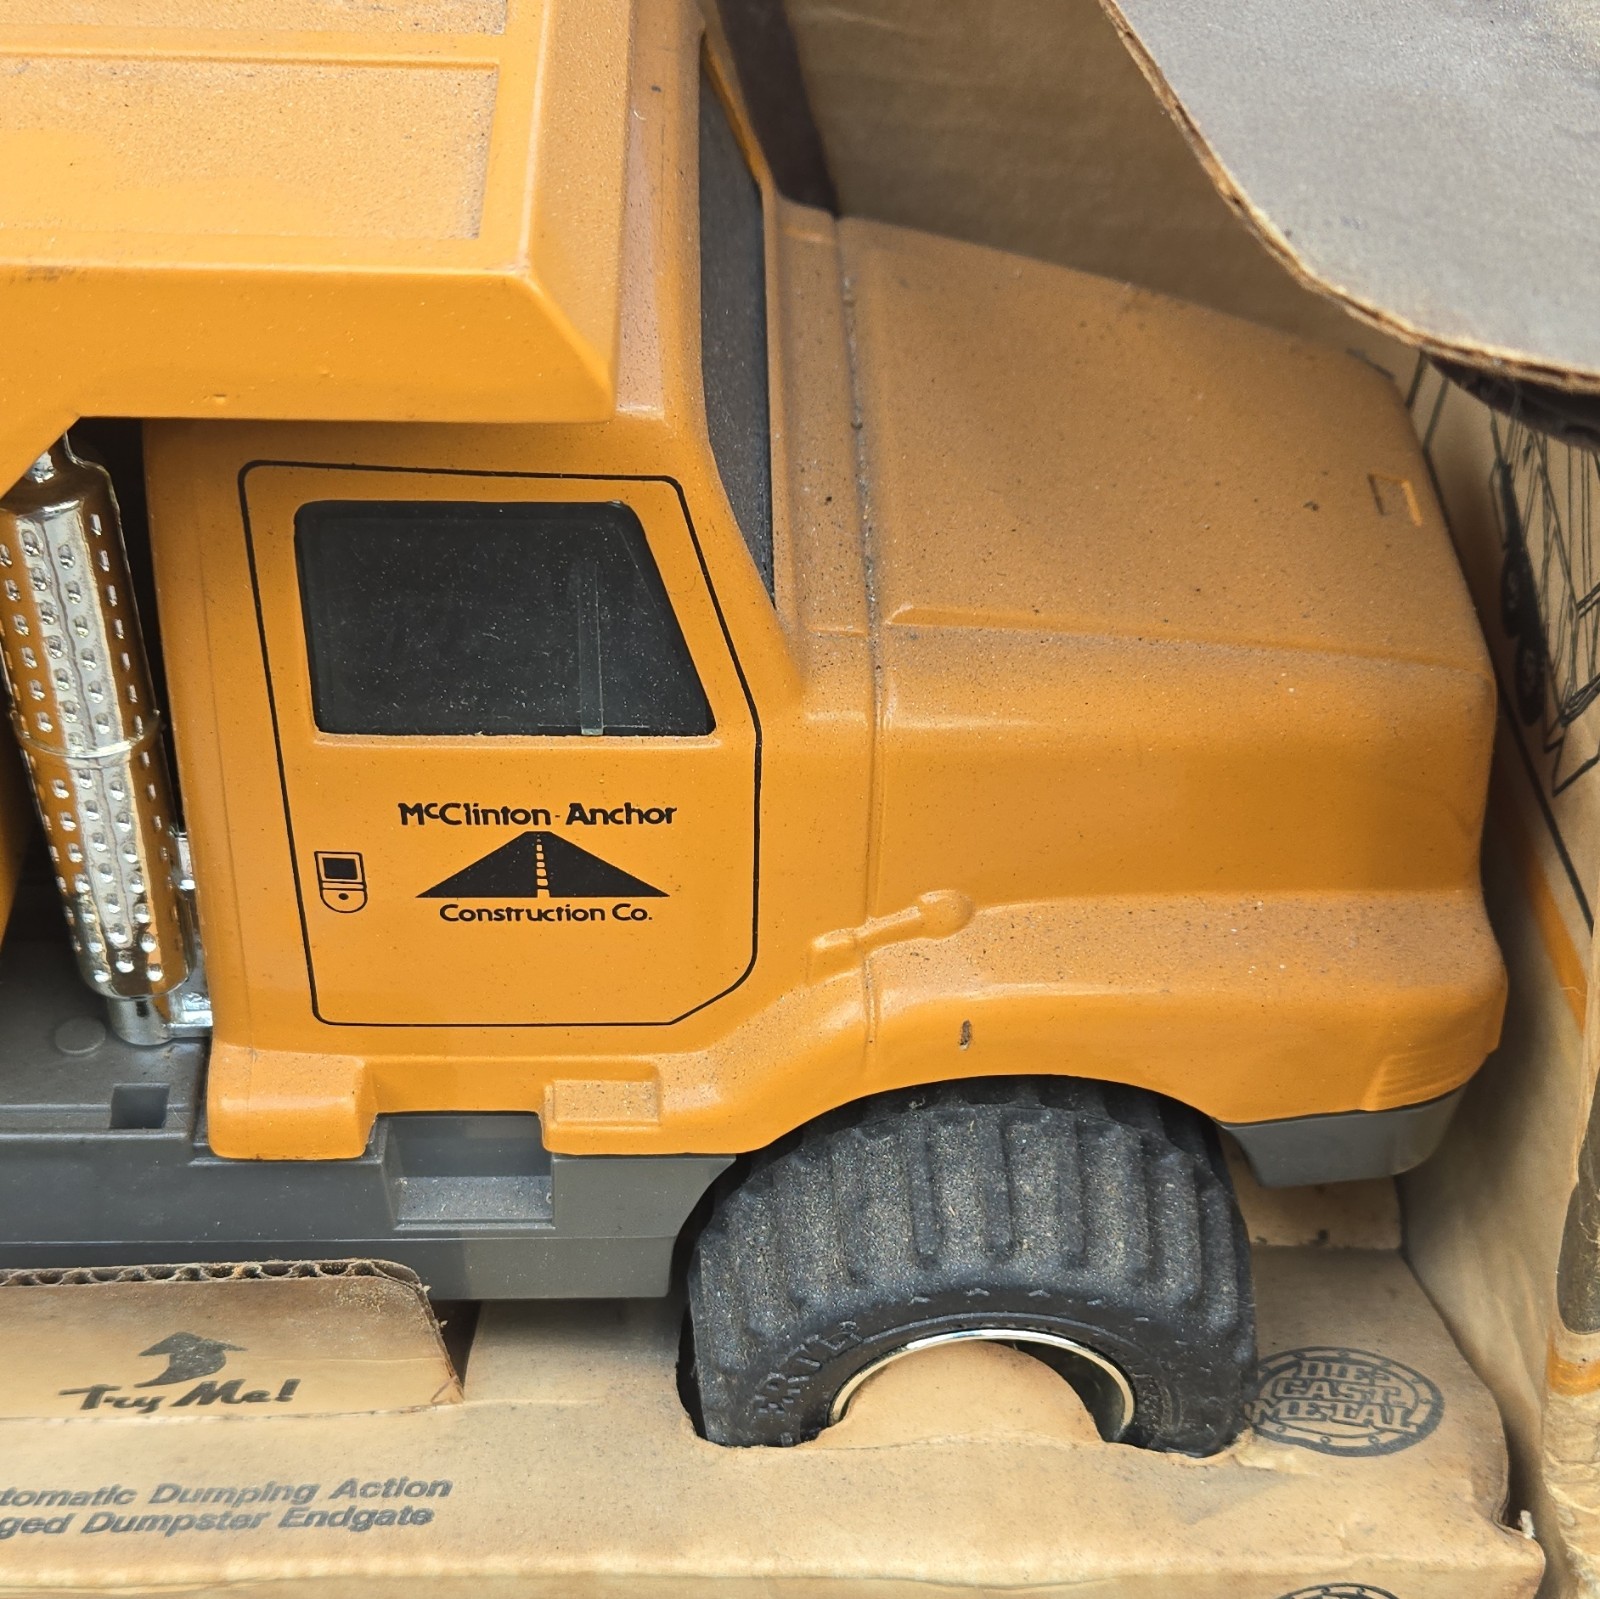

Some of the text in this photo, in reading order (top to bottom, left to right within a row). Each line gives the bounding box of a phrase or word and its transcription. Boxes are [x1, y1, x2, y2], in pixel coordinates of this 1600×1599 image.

[439, 903, 653, 922] Construction Co.
[1298, 1360, 1390, 1385] DIE
[59, 1379, 301, 1412] Try Me!
[1274, 1379, 1406, 1404] CAST
[1244, 1399, 1418, 1433] METAL
[149, 1480, 319, 1508] Dumping
[329, 1476, 453, 1499] Action
[81, 1509, 271, 1537] Dumpster
[279, 1505, 435, 1532] Endgate
